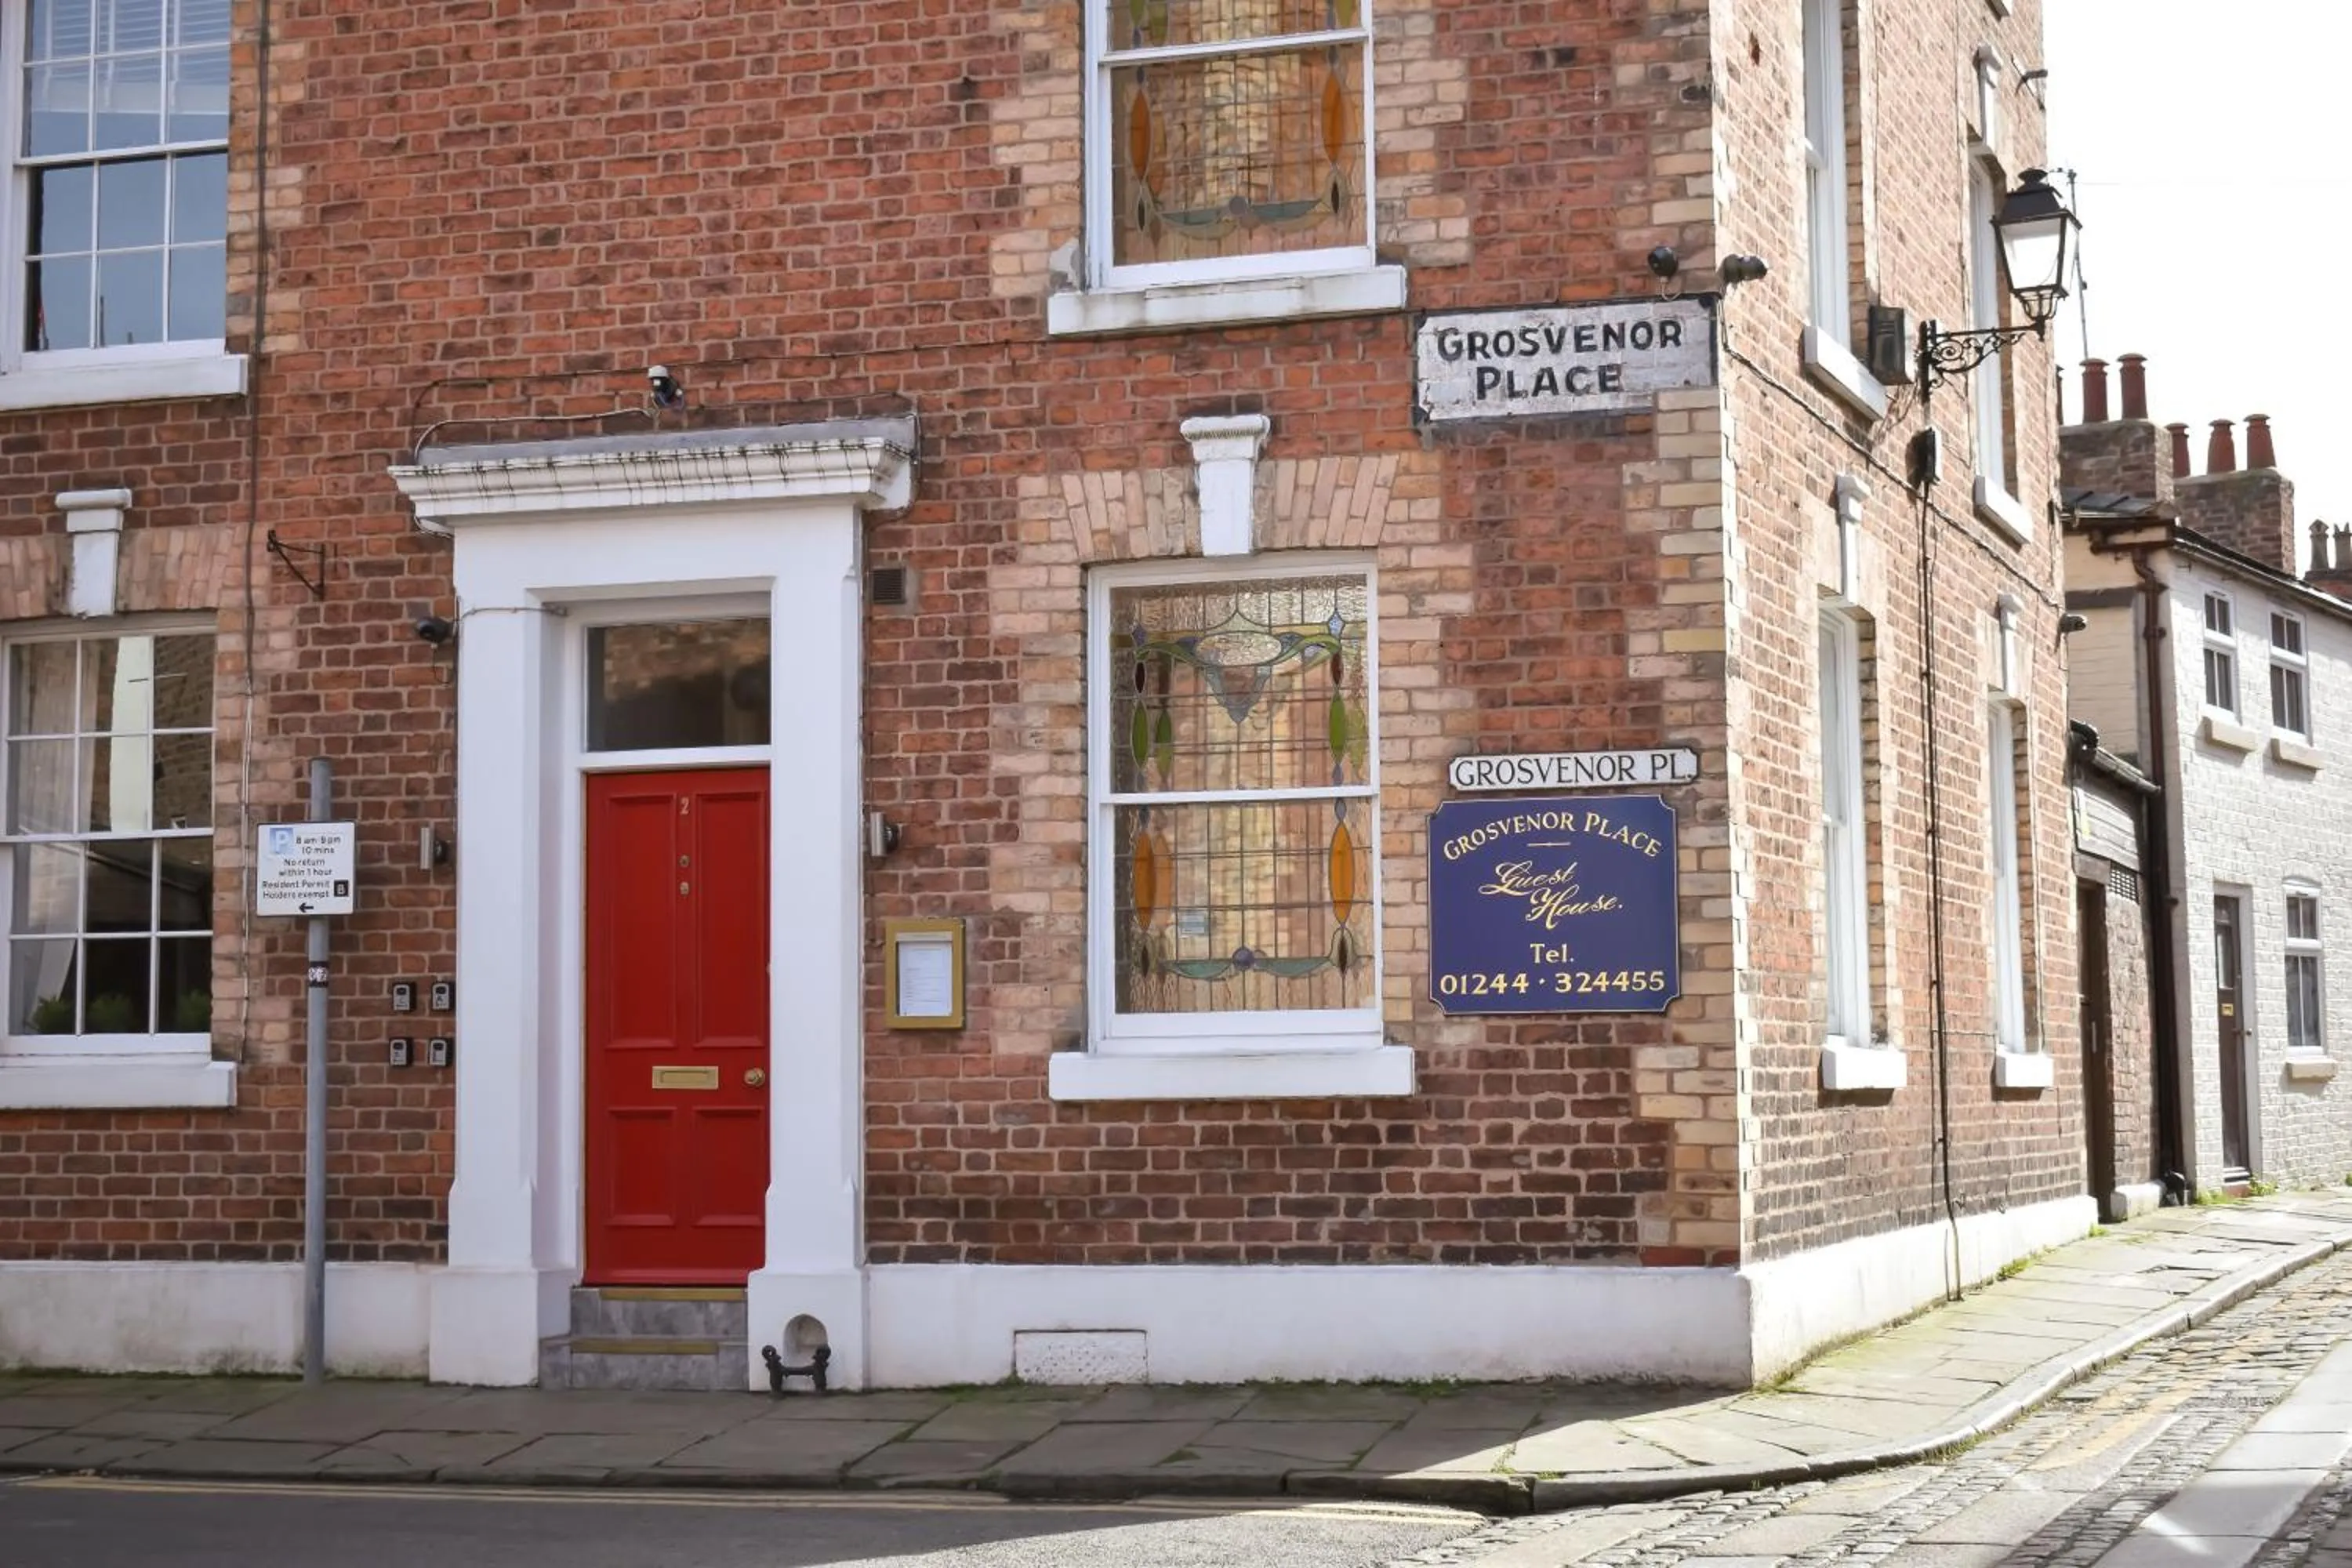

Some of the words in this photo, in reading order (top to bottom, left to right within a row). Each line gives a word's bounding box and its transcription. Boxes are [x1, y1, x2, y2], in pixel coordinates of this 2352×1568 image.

[1437, 319, 1682, 361] GROSVENOR
[1476, 363, 1624, 400] PLACE
[1454, 753, 1636, 786] GROSVENOR
[681, 797, 690, 815] 2
[1443, 811, 1576, 860] GROSVENOR
[1584, 811, 1662, 857] PLACE
[1479, 860, 1578, 896] Guest
[1530, 943, 1574, 964] Tel.
[1440, 972, 1530, 995] 01244
[1555, 971, 1665, 993] 324455
